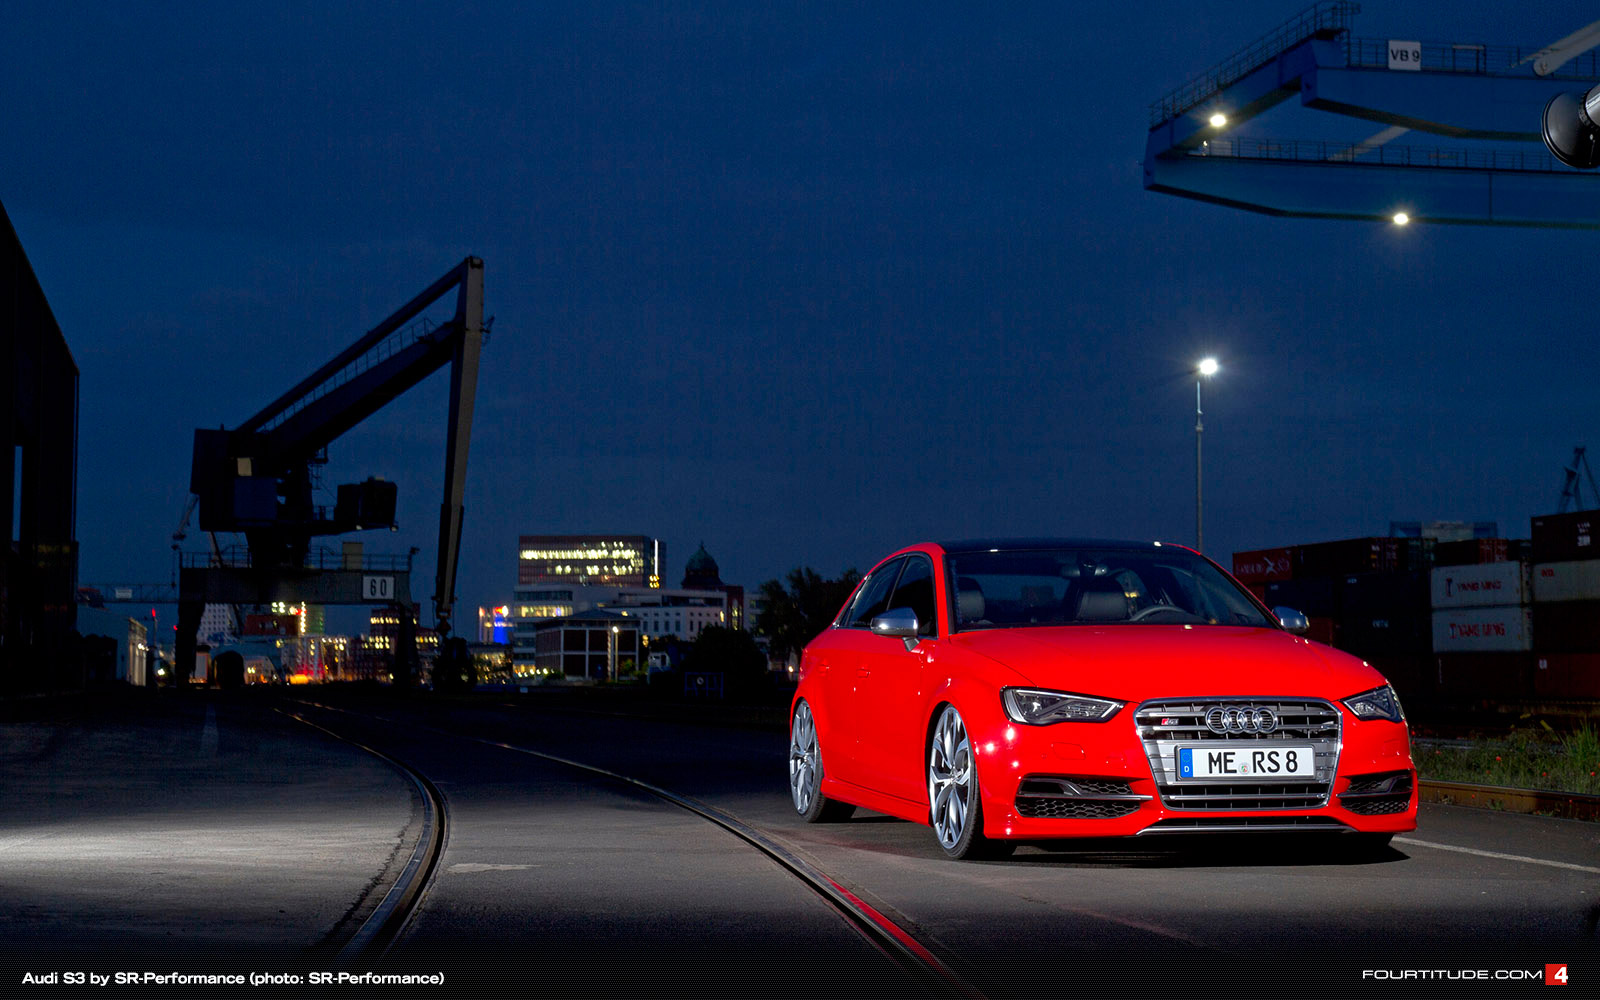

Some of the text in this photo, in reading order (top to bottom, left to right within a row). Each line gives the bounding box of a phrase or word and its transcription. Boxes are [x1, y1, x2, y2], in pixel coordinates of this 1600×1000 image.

[1390, 49, 1420, 62] VB 9
[370, 578, 387, 596] 60
[1183, 765, 1190, 773] D
[1208, 750, 1298, 774] ME RS 8
